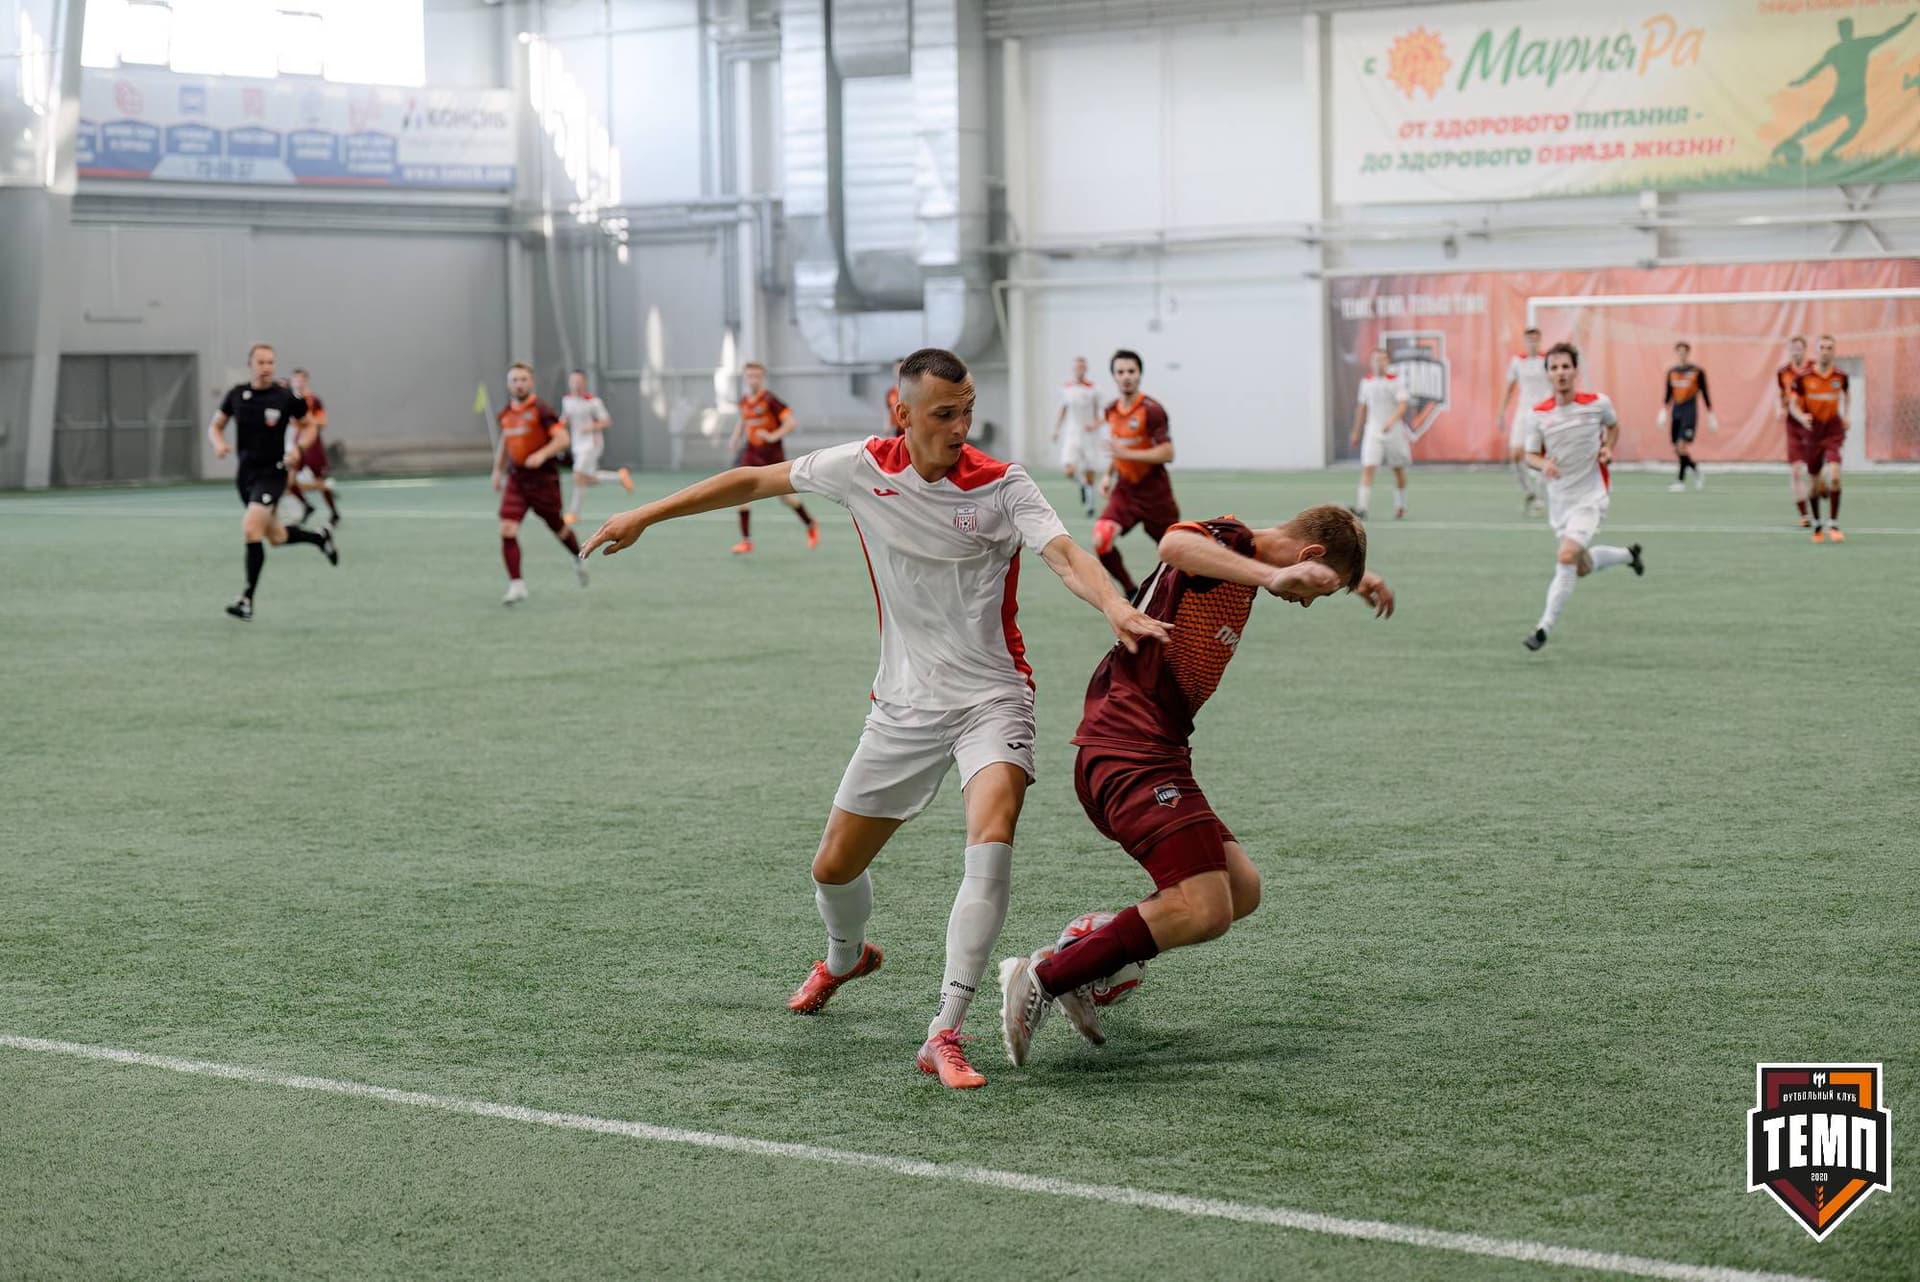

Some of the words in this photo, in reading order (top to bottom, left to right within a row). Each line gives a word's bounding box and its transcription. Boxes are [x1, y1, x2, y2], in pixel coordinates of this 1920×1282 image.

[1399, 120, 1427, 140] ОТ
[1432, 112, 1570, 139] ЗДОРОВОГО
[1575, 105, 1690, 130] ПИТАНИЯ
[1360, 152, 1393, 174] ДО
[1397, 147, 1532, 172] ЗДОРОВОГО
[1536, 141, 1626, 165] ОБРАЗА
